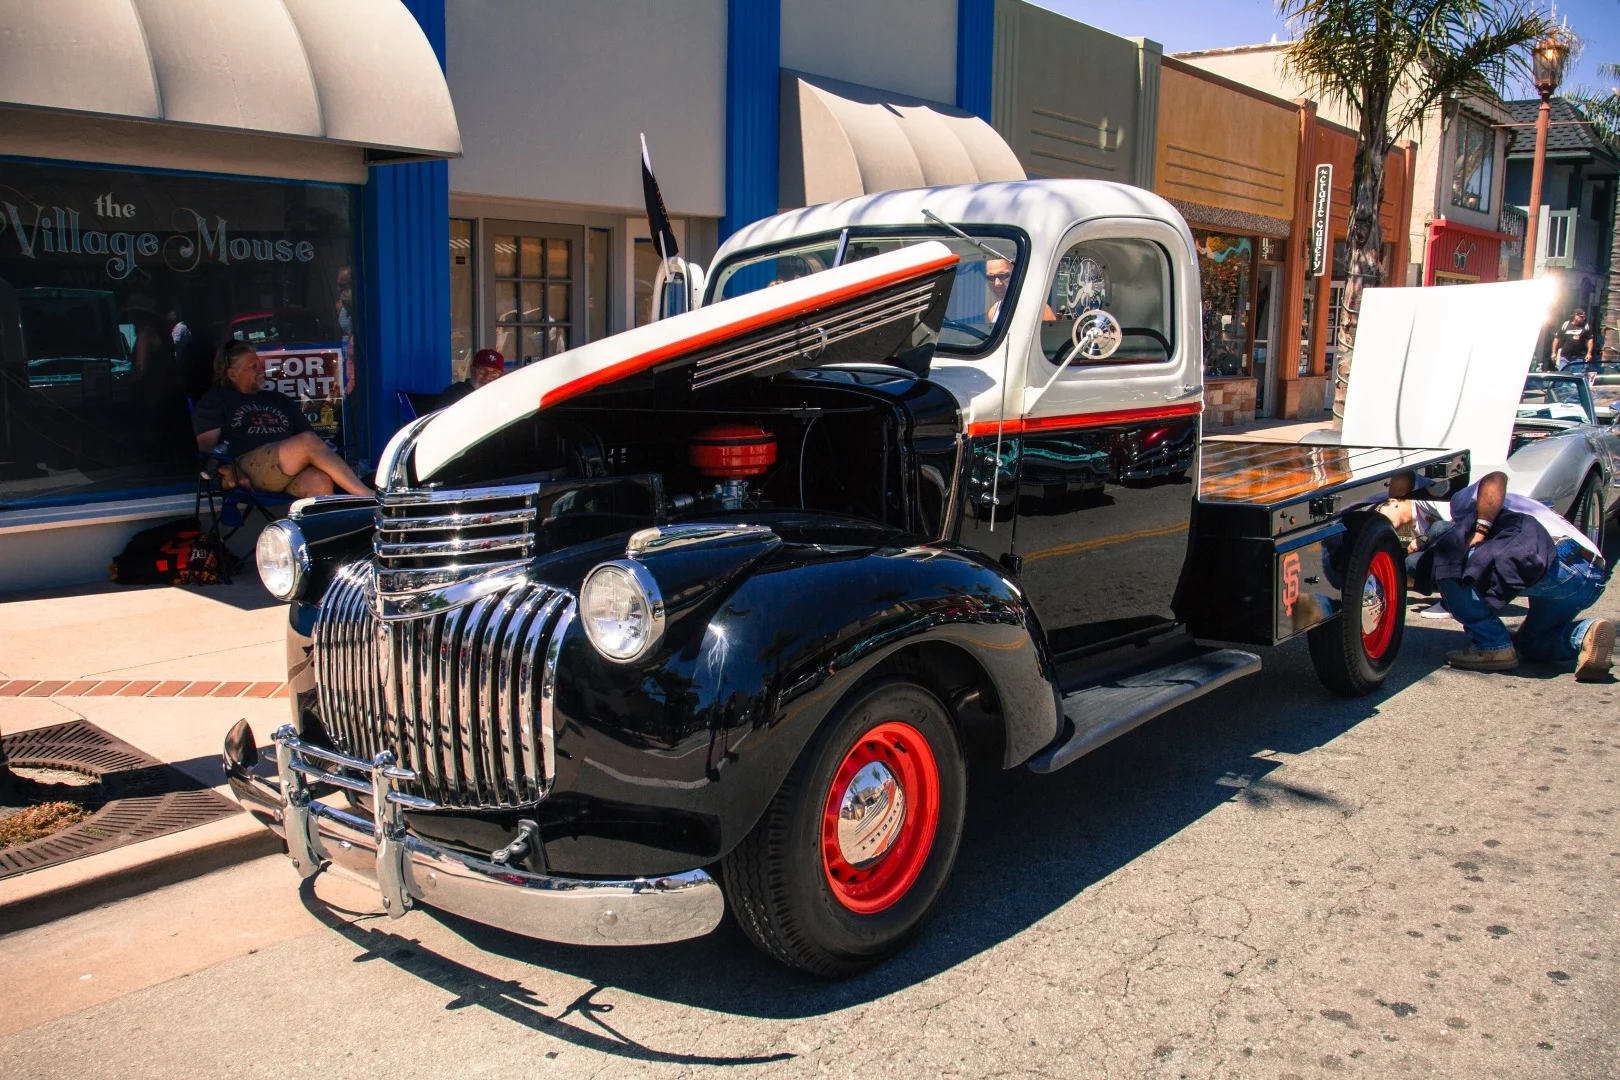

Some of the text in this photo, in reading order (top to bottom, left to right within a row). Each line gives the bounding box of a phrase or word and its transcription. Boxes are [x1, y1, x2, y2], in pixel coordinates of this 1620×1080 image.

[93, 191, 137, 219] the
[1, 198, 315, 280] Village Mouse
[264, 356, 325, 378] FOR
[230, 408, 245, 428] SAN
